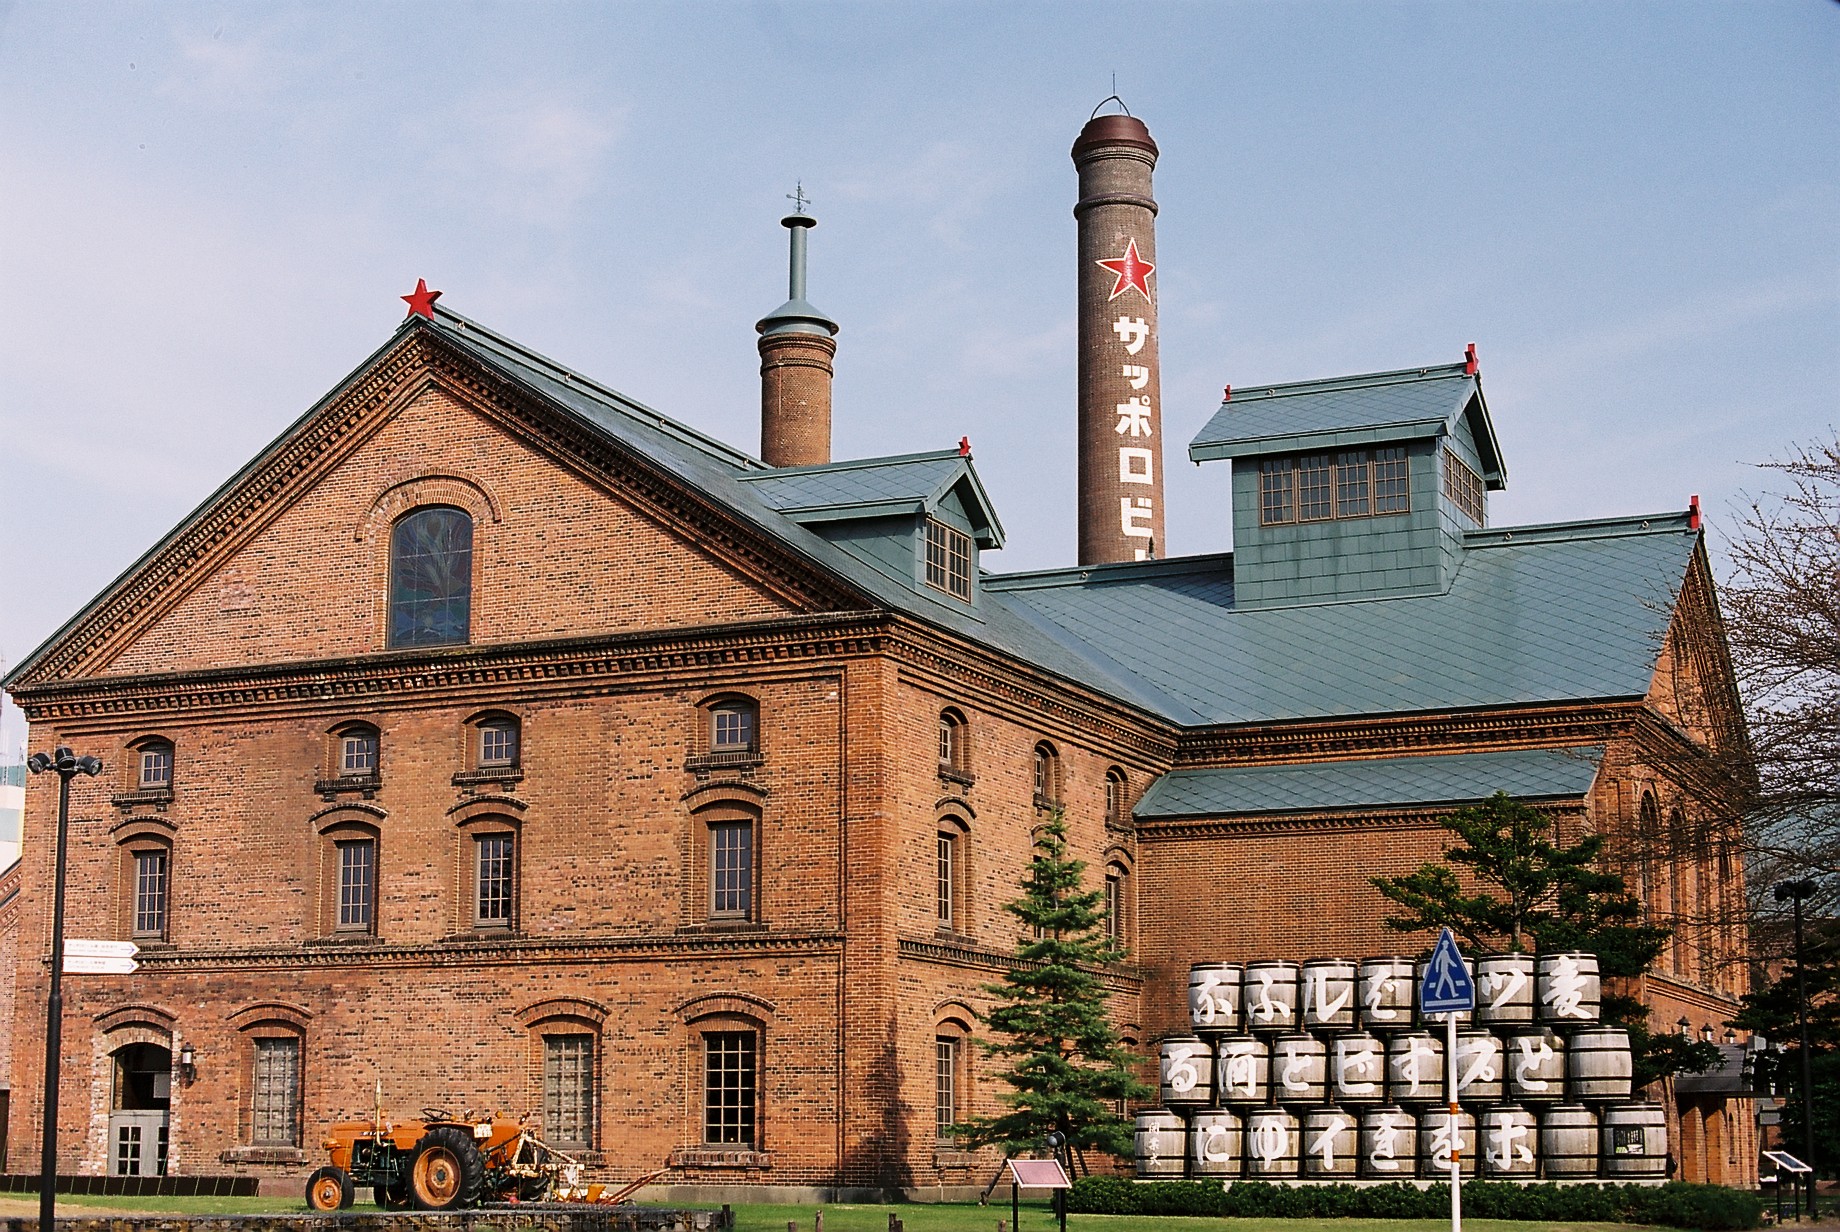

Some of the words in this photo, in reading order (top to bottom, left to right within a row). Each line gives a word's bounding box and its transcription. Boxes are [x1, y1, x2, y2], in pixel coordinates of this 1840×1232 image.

[1113, 316, 1154, 560] サッポロビ
